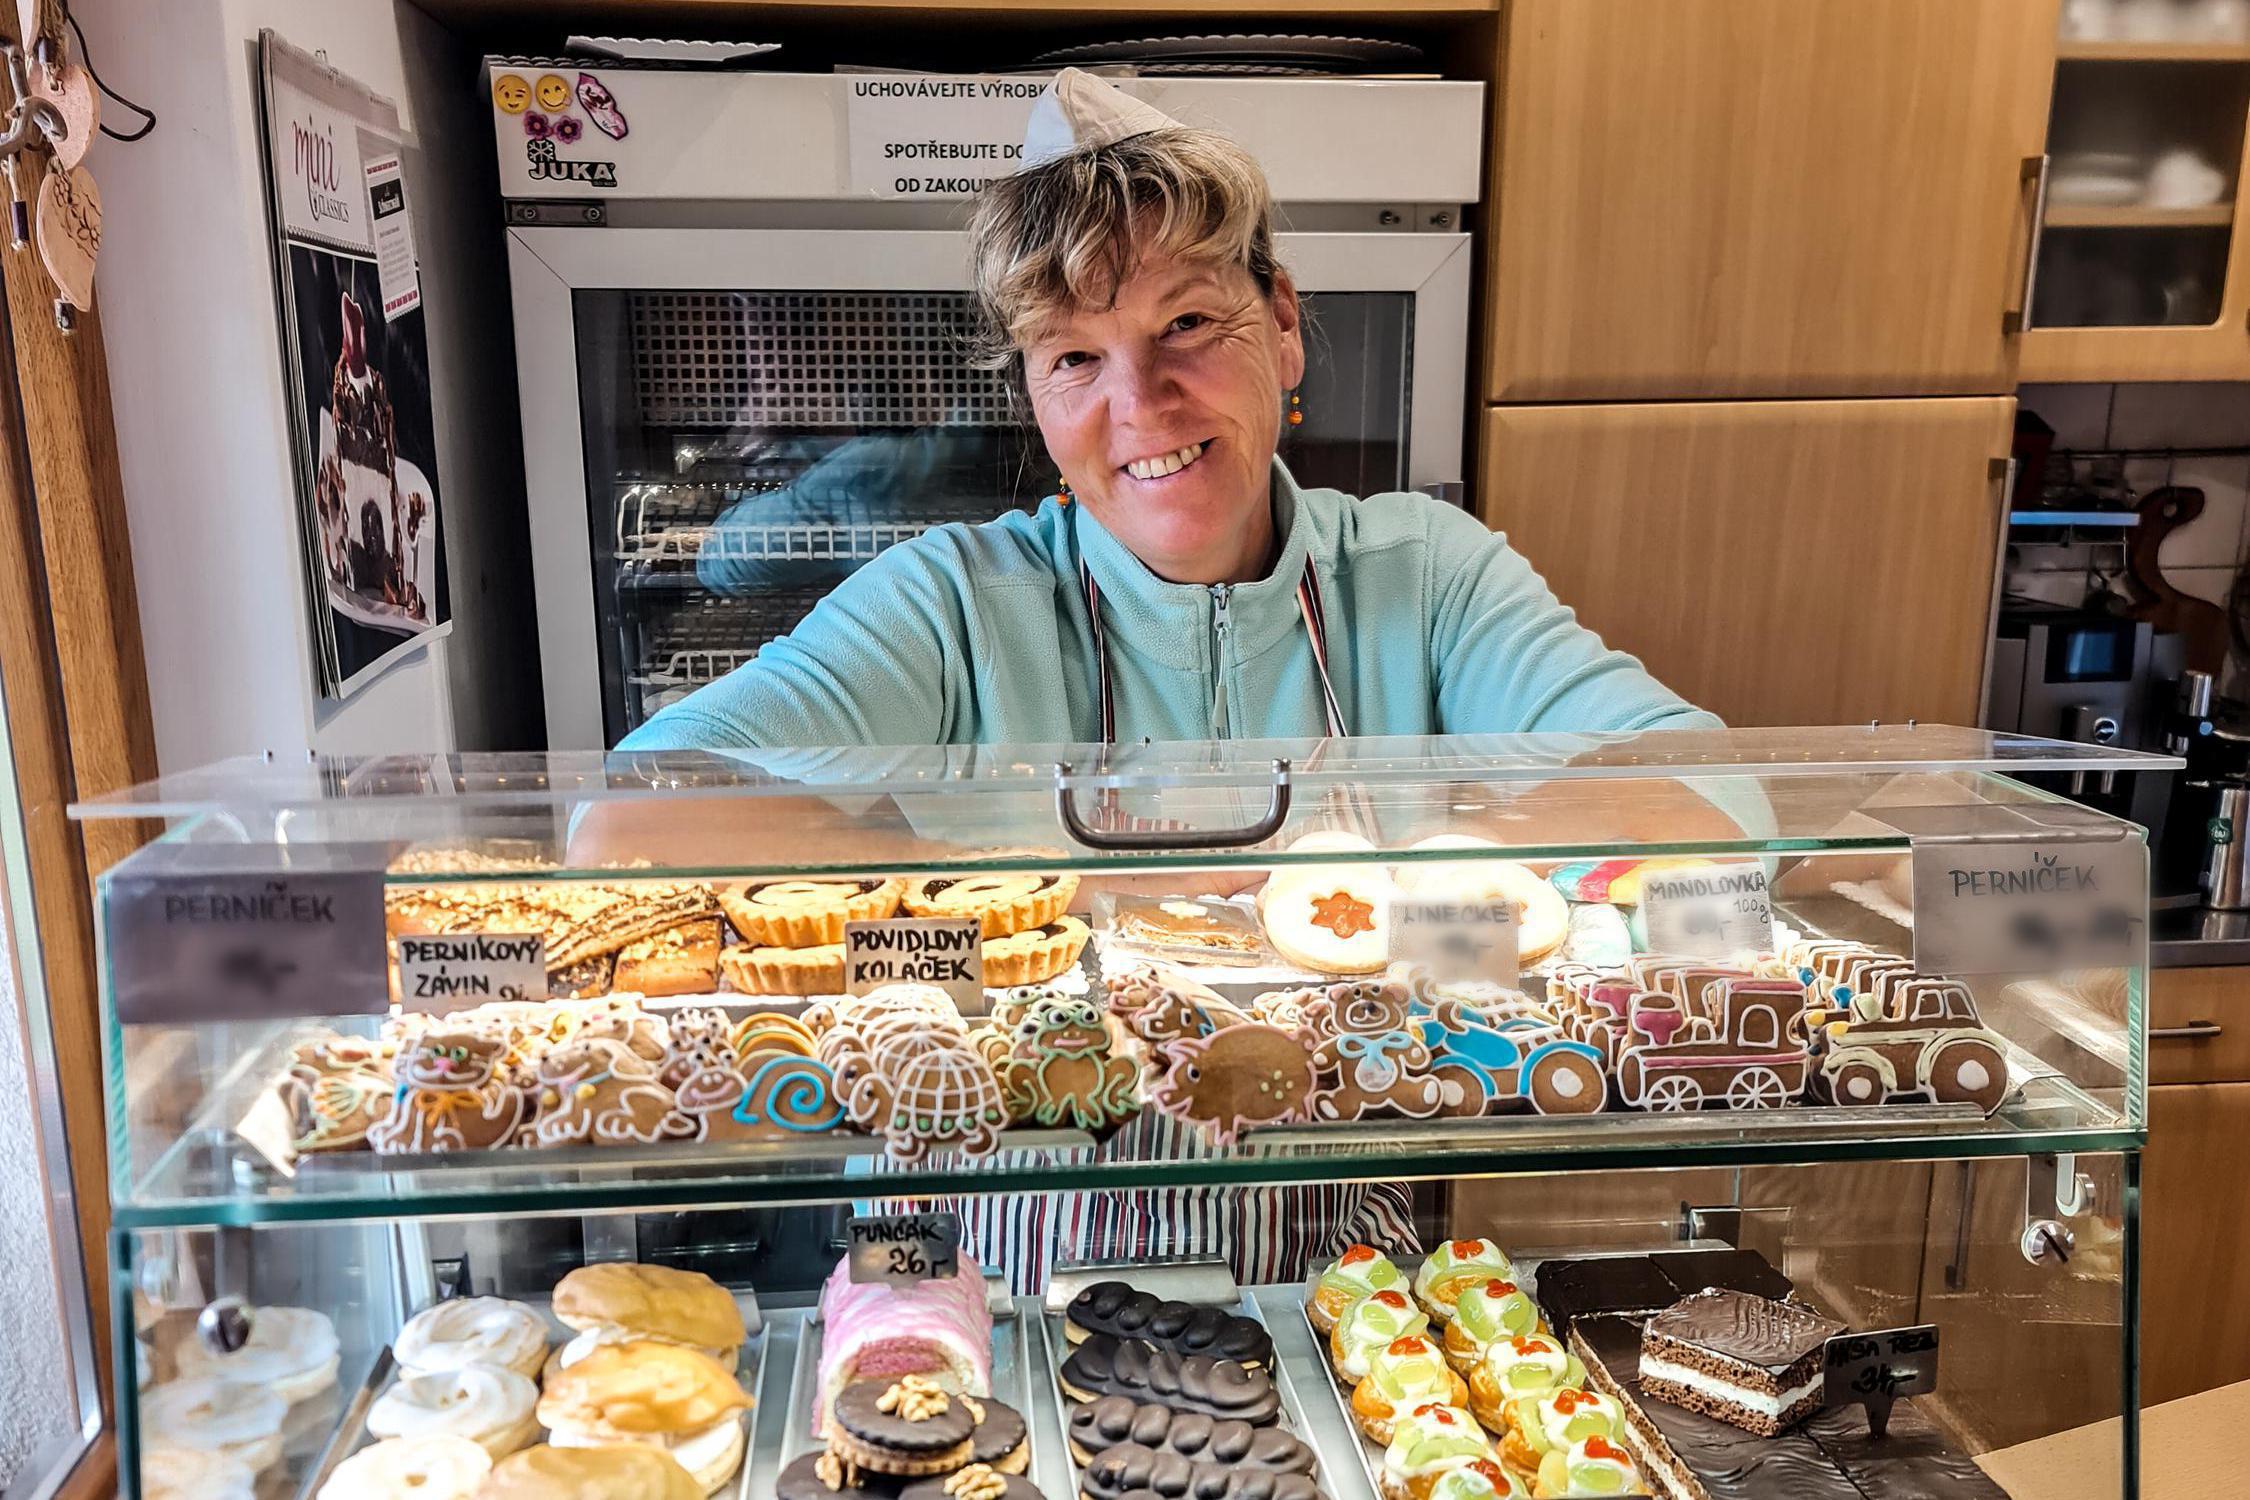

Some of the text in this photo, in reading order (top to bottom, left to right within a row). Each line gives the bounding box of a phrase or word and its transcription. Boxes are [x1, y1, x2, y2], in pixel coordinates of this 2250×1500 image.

[855, 79, 976, 97] UCHOVÁVEJTE
[884, 140, 997, 159] SPOTŘEBUJTE
[530, 162, 613, 180] JUKA
[895, 178, 920, 192] OD
[1648, 871, 1767, 901] MANDLOVKA
[1949, 851, 2099, 897] PERNÍČEK
[402, 935, 541, 964] PERNÍKOVÝ
[850, 919, 978, 952] POVIDLOVÝ
[415, 965, 489, 997] ZÁVIN
[854, 952, 975, 983] KOLÁČEK
